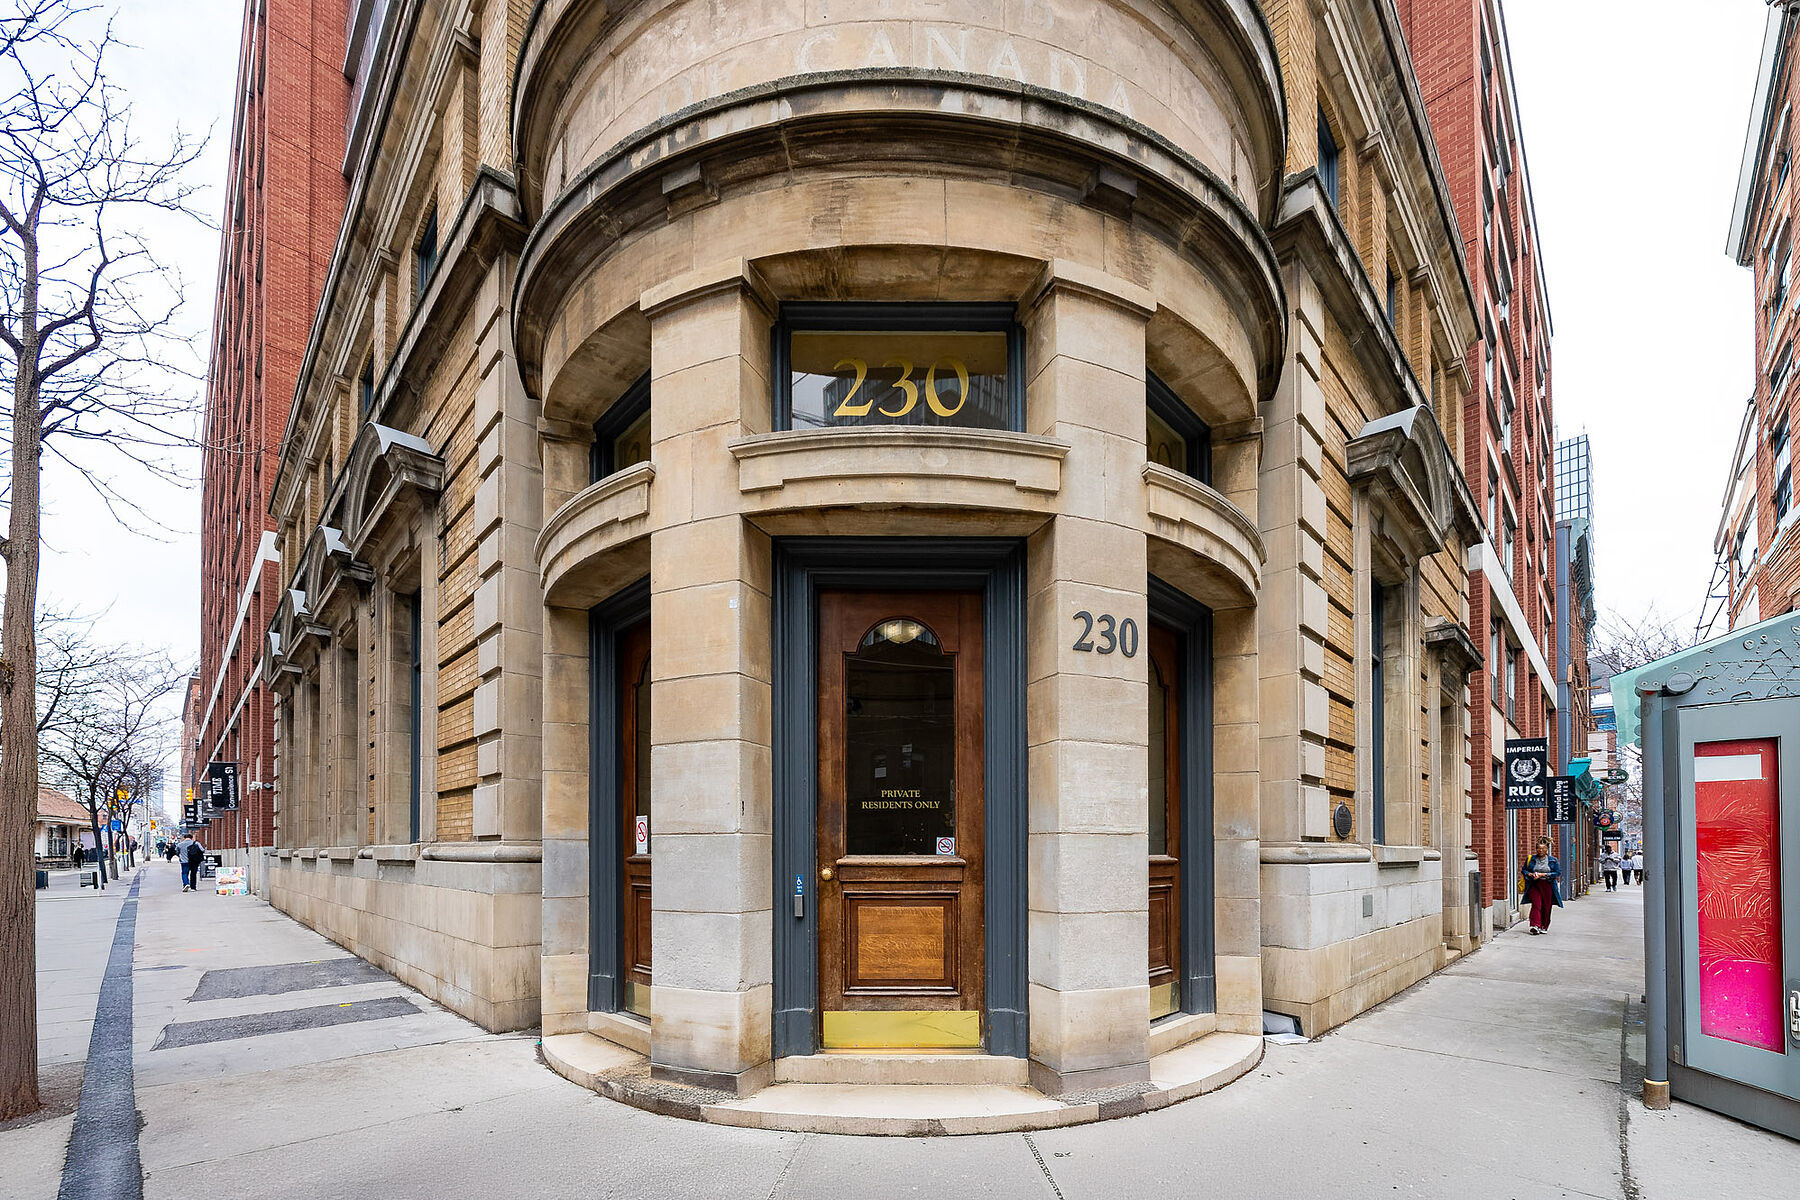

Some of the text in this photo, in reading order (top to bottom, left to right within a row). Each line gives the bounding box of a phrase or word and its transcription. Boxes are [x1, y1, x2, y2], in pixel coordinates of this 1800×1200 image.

[793, 27, 1138, 121] CANADA
[832, 355, 970, 418] 230
[1072, 610, 1139, 659] 230
[1506, 745, 1545, 754] IMPERIAL
[881, 789, 921, 798] PRIVATE
[1508, 785, 1544, 796] RUG
[1554, 780, 1564, 821] Imperial Rug
[861, 801, 941, 810] RESIDENTS ONLY
